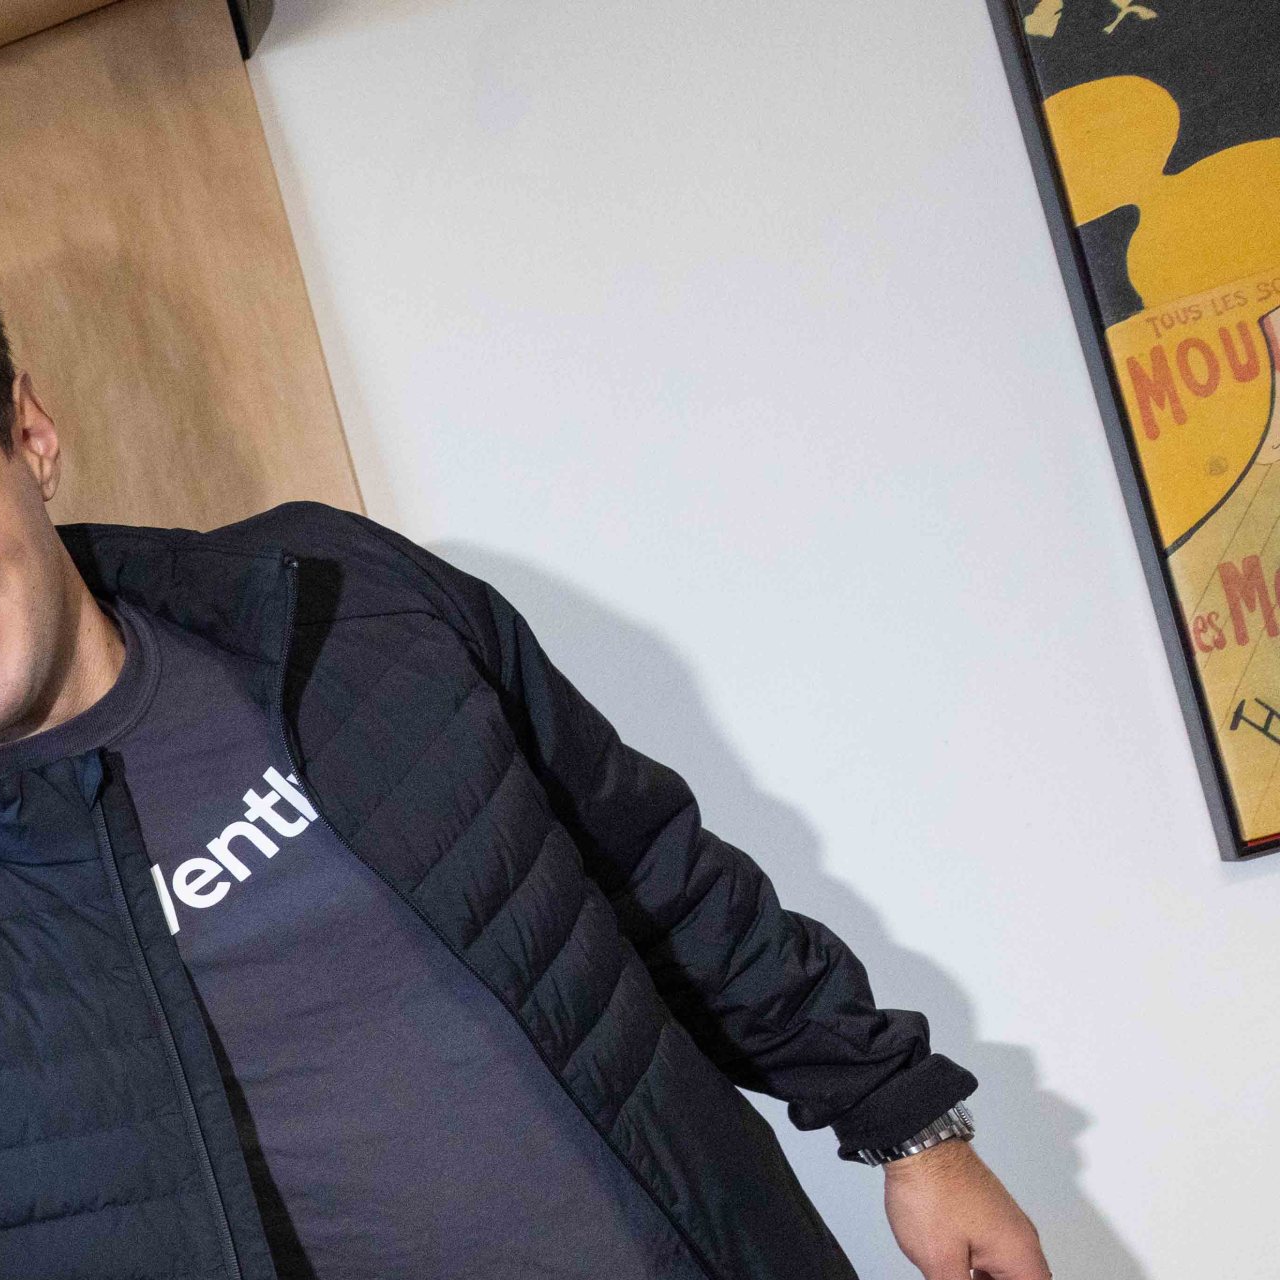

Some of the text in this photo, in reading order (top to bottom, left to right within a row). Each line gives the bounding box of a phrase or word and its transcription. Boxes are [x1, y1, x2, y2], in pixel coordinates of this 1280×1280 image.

[1145, 304, 1204, 338] TOUS
[1211, 290, 1248, 316] LES
[1218, 554, 1280, 647] M
